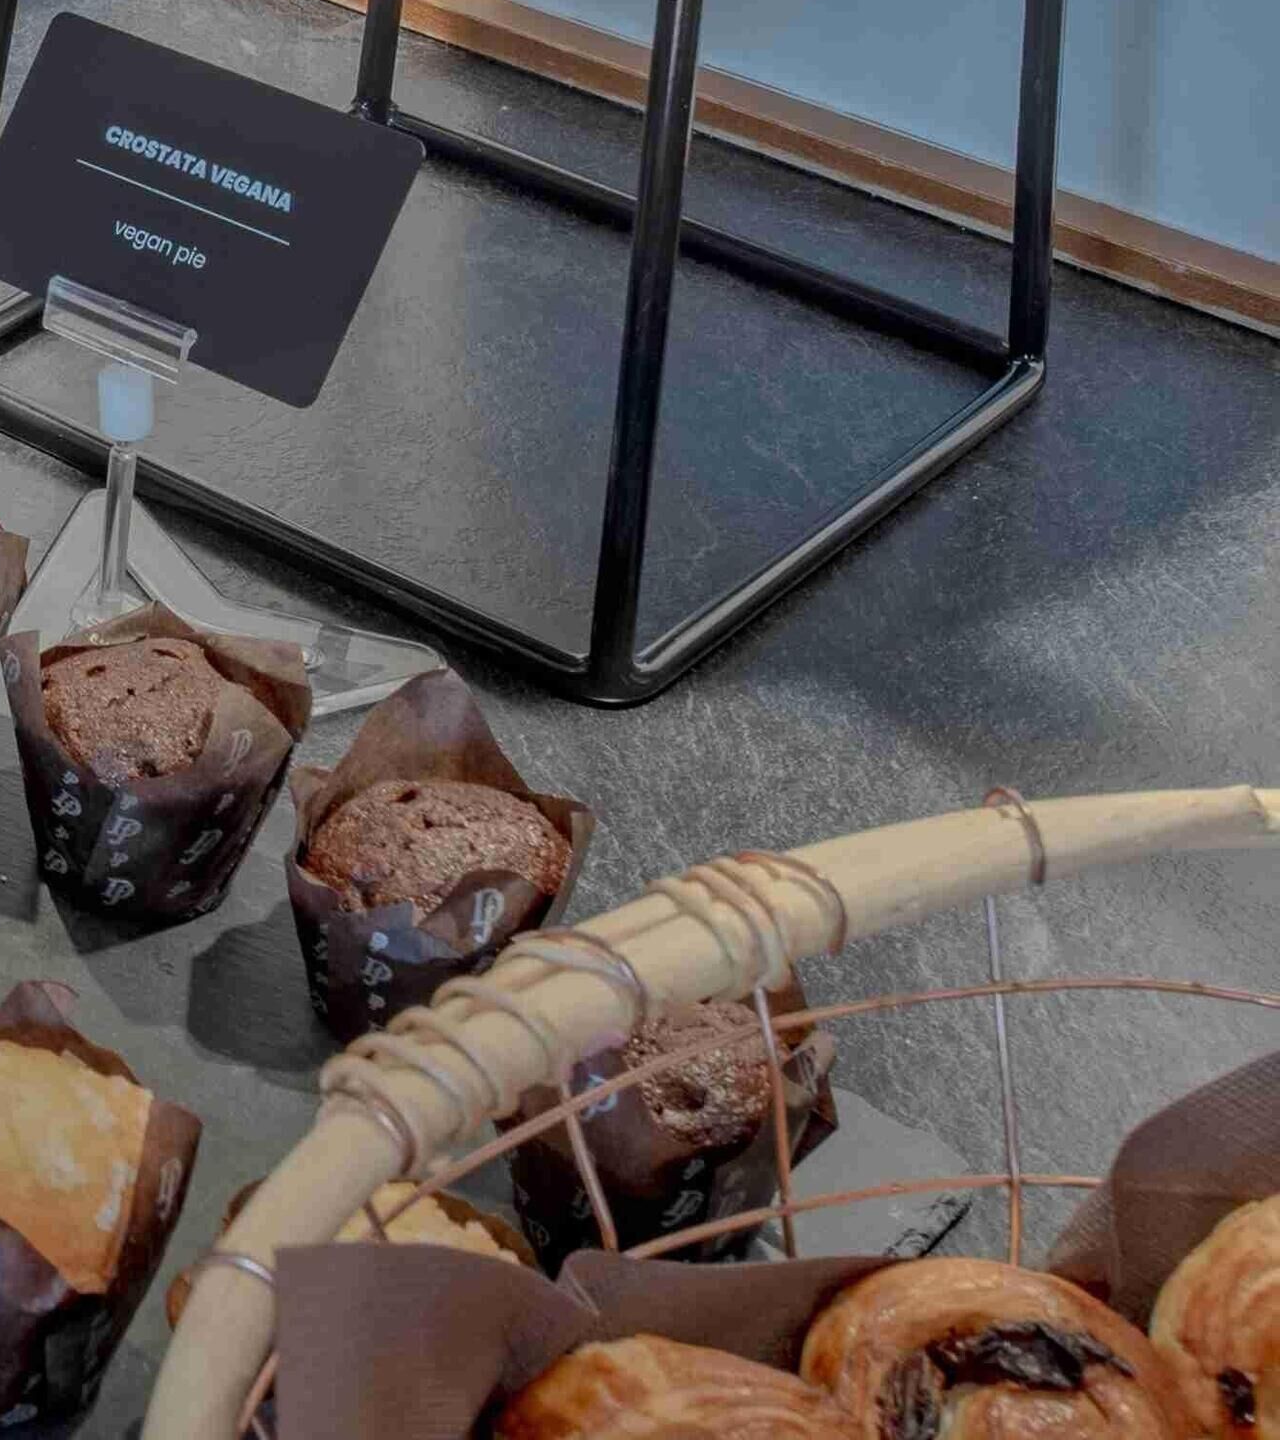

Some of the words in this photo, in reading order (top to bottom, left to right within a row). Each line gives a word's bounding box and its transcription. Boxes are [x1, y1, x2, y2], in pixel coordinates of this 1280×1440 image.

[105, 126, 207, 178] CROSTATA
[210, 164, 293, 213] VEGANA
[114, 220, 173, 256] vegan
[172, 246, 206, 269] pie
